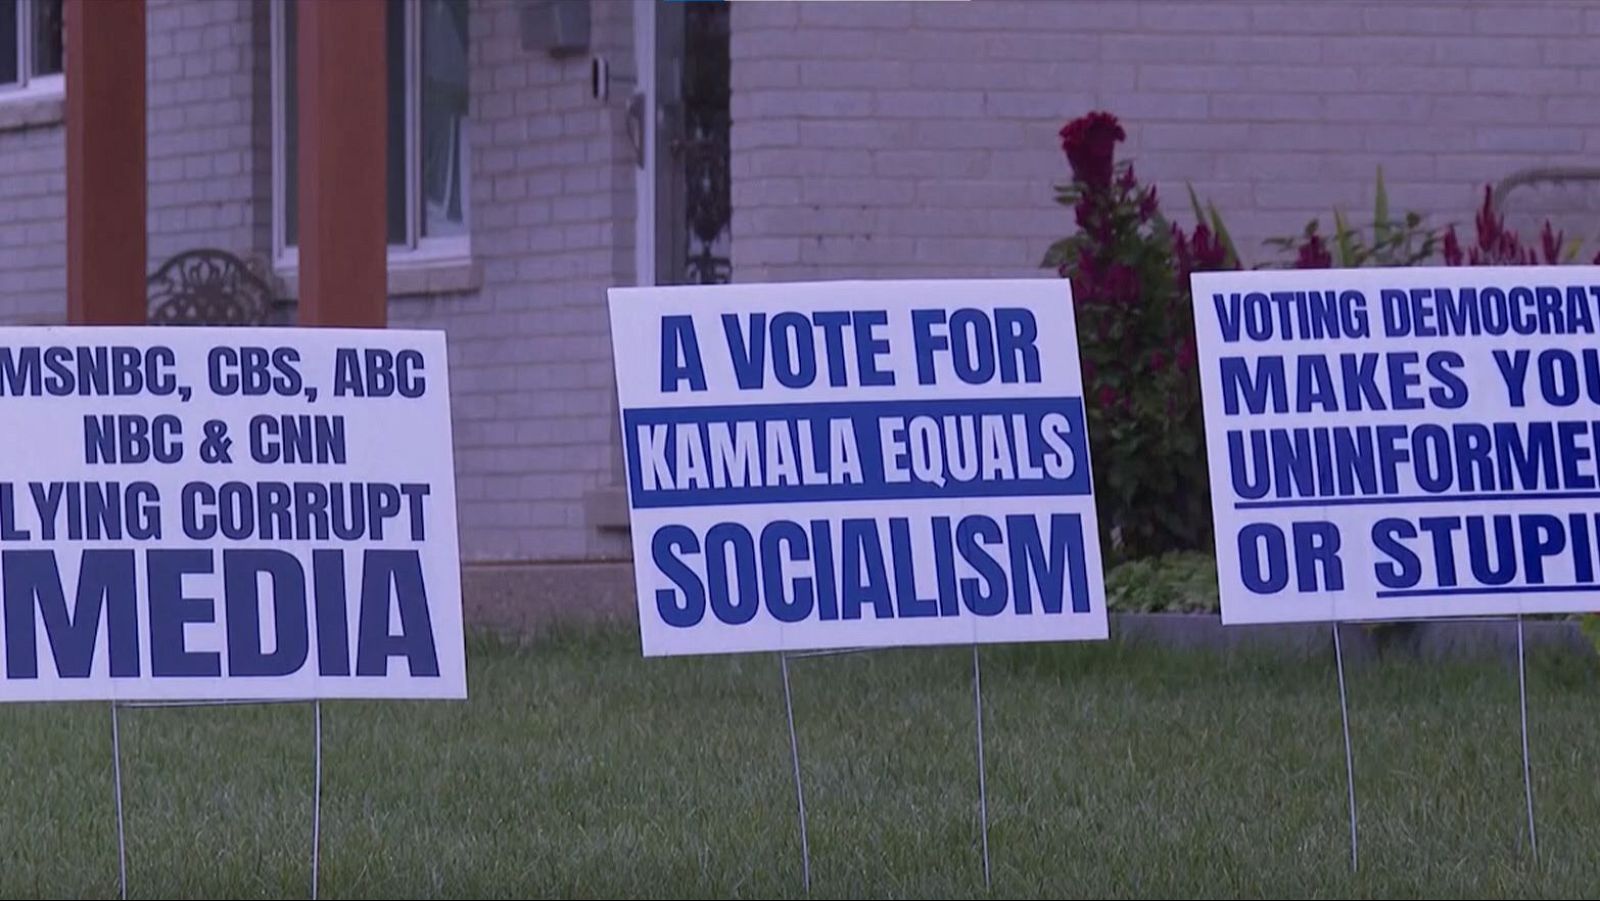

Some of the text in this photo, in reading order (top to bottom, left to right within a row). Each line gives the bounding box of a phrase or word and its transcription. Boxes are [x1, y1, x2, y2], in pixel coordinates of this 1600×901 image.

[660, 307, 1042, 393] A VOTE FOR
[1212, 289, 1371, 343] VOTING
[0, 345, 427, 402] MSNBC, CBS, ABC
[1218, 350, 1470, 416] MAKES
[83, 413, 347, 465] NBC & CNN
[636, 411, 1076, 492] KAMALA EQUALS
[1226, 420, 1600, 500] UNINFORME
[0, 480, 431, 542] LYING CORRUPT
[650, 512, 1091, 629] SOCIALISM
[1237, 512, 1600, 595] OR STUPI
[0, 548, 441, 680] MEDIA
